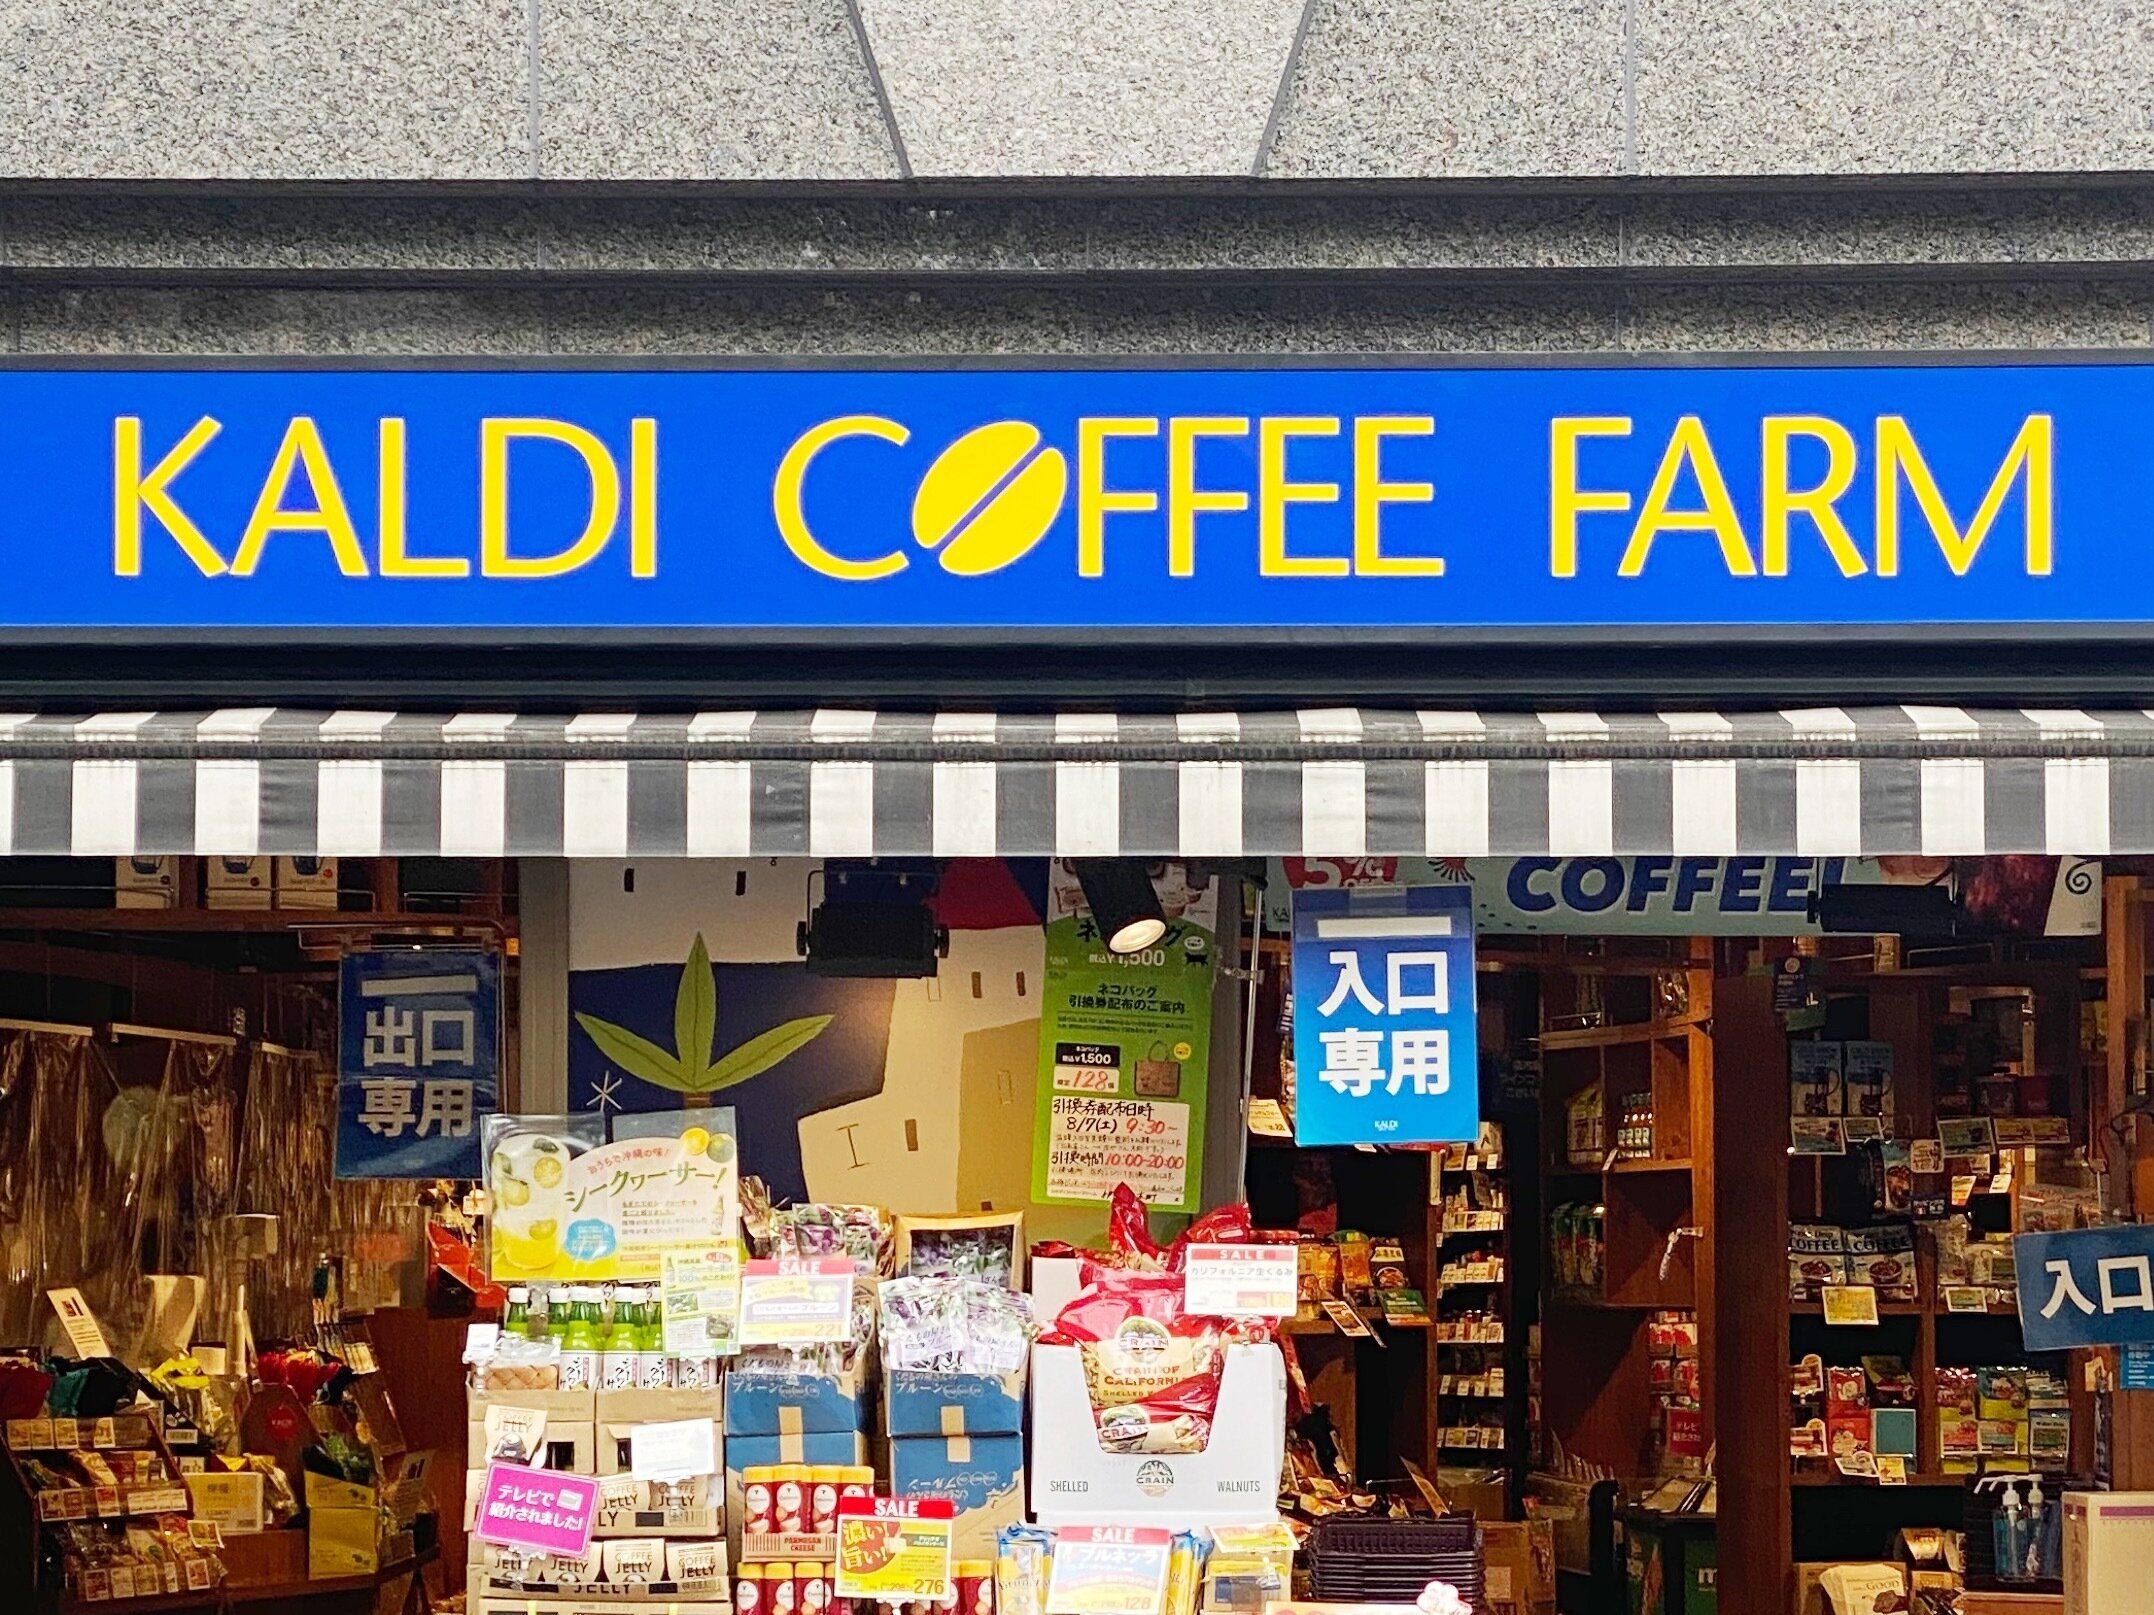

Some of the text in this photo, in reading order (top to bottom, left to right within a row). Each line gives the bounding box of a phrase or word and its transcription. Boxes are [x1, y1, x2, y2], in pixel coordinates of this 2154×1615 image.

[117, 418, 655, 576] KALDI
[1552, 416, 2051, 575] FARM
[1098, 982, 1158, 998] ネコバッグ
[1316, 950, 1450, 1017] 入口
[1068, 994, 1186, 1015] 引換券配布のご案内
[362, 1007, 476, 1068] 出口
[1317, 1027, 1450, 1098] 専用
[357, 1078, 474, 1139] 専用
[1219, 1248, 1265, 1260] SALE
[778, 1260, 821, 1275] SALE
[1191, 1266, 1294, 1277] カリフォルニア生くるみ
[2039, 1255, 2154, 1319] 入口
[1049, 1480, 1261, 1493] SHELLED WALNUTS
[1135, 1476, 1175, 1485] CRAIN
[497, 1484, 556, 1509] テレビで
[600, 1483, 639, 1497] COFFEE
[602, 1493, 639, 1510] JELLY
[873, 1498, 920, 1518] SALE
[487, 1500, 584, 1532] 紹介されました!
[842, 1520, 890, 1546] 濃い!
[1091, 1527, 1136, 1543] SALE
[790, 1544, 816, 1552] CHEESE
[615, 1551, 654, 1562] COFFEE
[678, 1555, 716, 1567] COFFEE
[841, 1546, 889, 1570] 旨い!
[550, 1559, 589, 1574] JELLY
[615, 1561, 653, 1575] JELLY
[679, 1564, 716, 1580] JELLY
[914, 1578, 945, 1595] 276
[1125, 1596, 1152, 1610] 128
